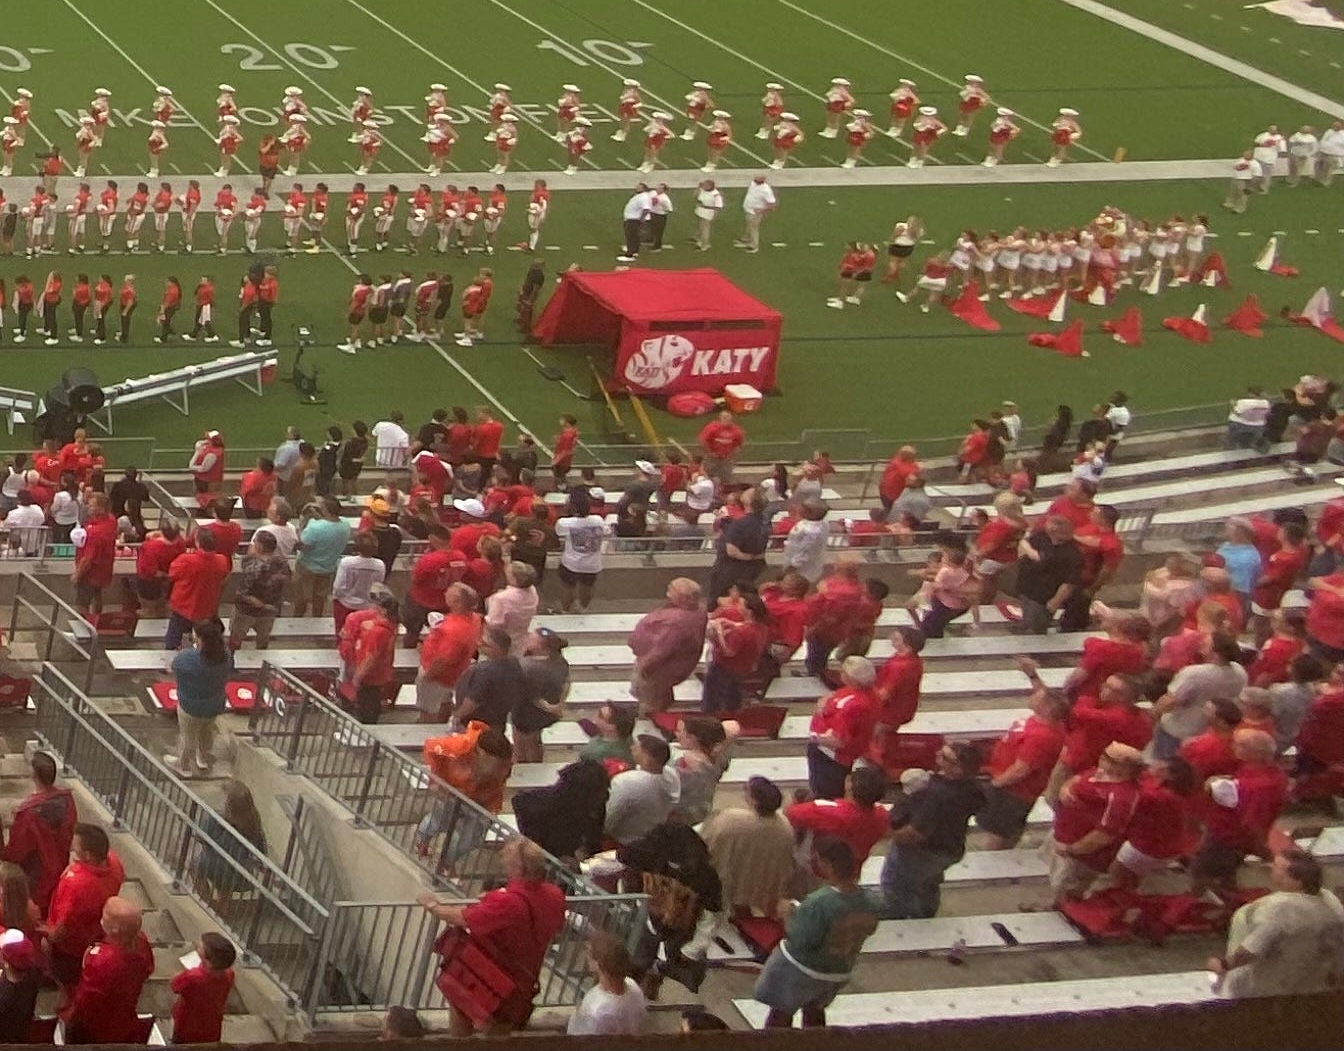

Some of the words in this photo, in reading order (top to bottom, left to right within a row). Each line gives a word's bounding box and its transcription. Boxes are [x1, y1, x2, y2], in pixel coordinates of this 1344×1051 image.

[220, 42, 340, 70] 20
[537, 39, 643, 67] 10
[691, 346, 769, 376] KATY
